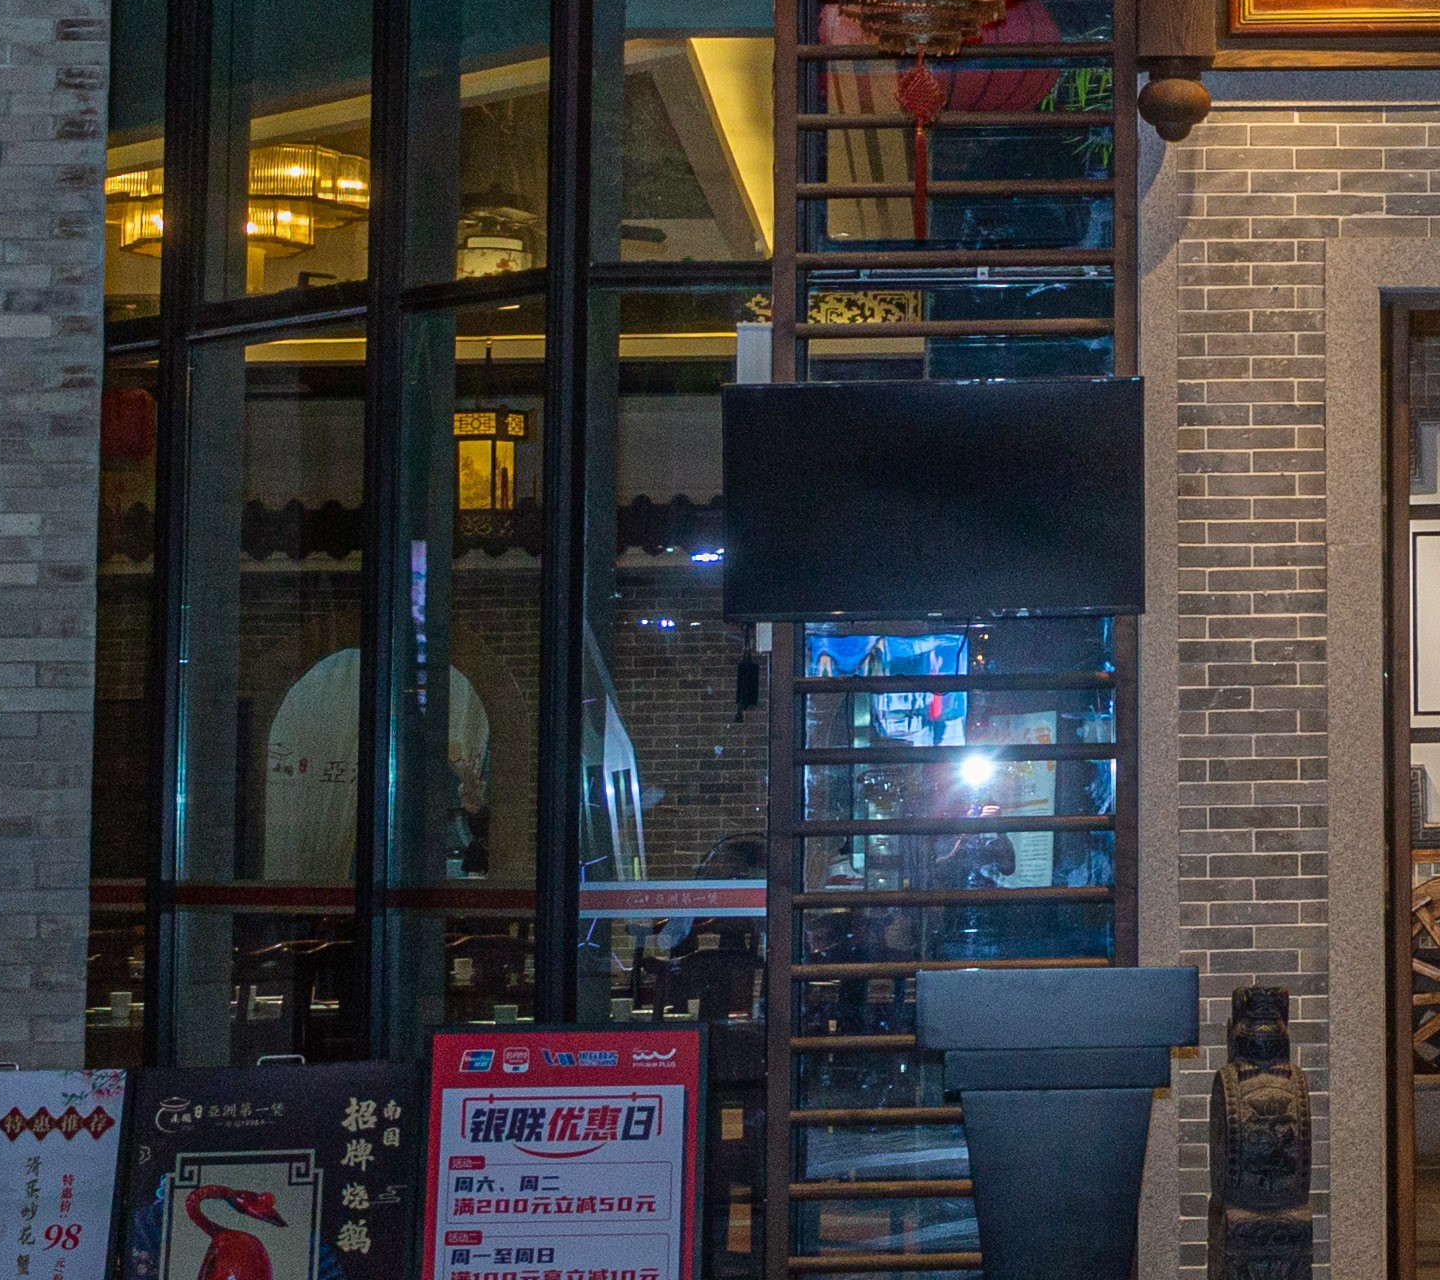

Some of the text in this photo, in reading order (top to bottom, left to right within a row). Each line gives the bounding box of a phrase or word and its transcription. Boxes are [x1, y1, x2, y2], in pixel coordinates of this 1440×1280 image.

[3, 1112, 109, 1134] 特惠推荐
[382, 1099, 402, 1148] 南国
[470, 1105, 656, 1143] 银联优惠日
[336, 1096, 377, 1255] 招牌烧鹅
[454, 1175, 560, 1194] 周六、周二
[453, 1195, 657, 1216] 满200元立减50元
[42, 1223, 83, 1252] 98
[450, 1247, 556, 1265] 周一至周日
